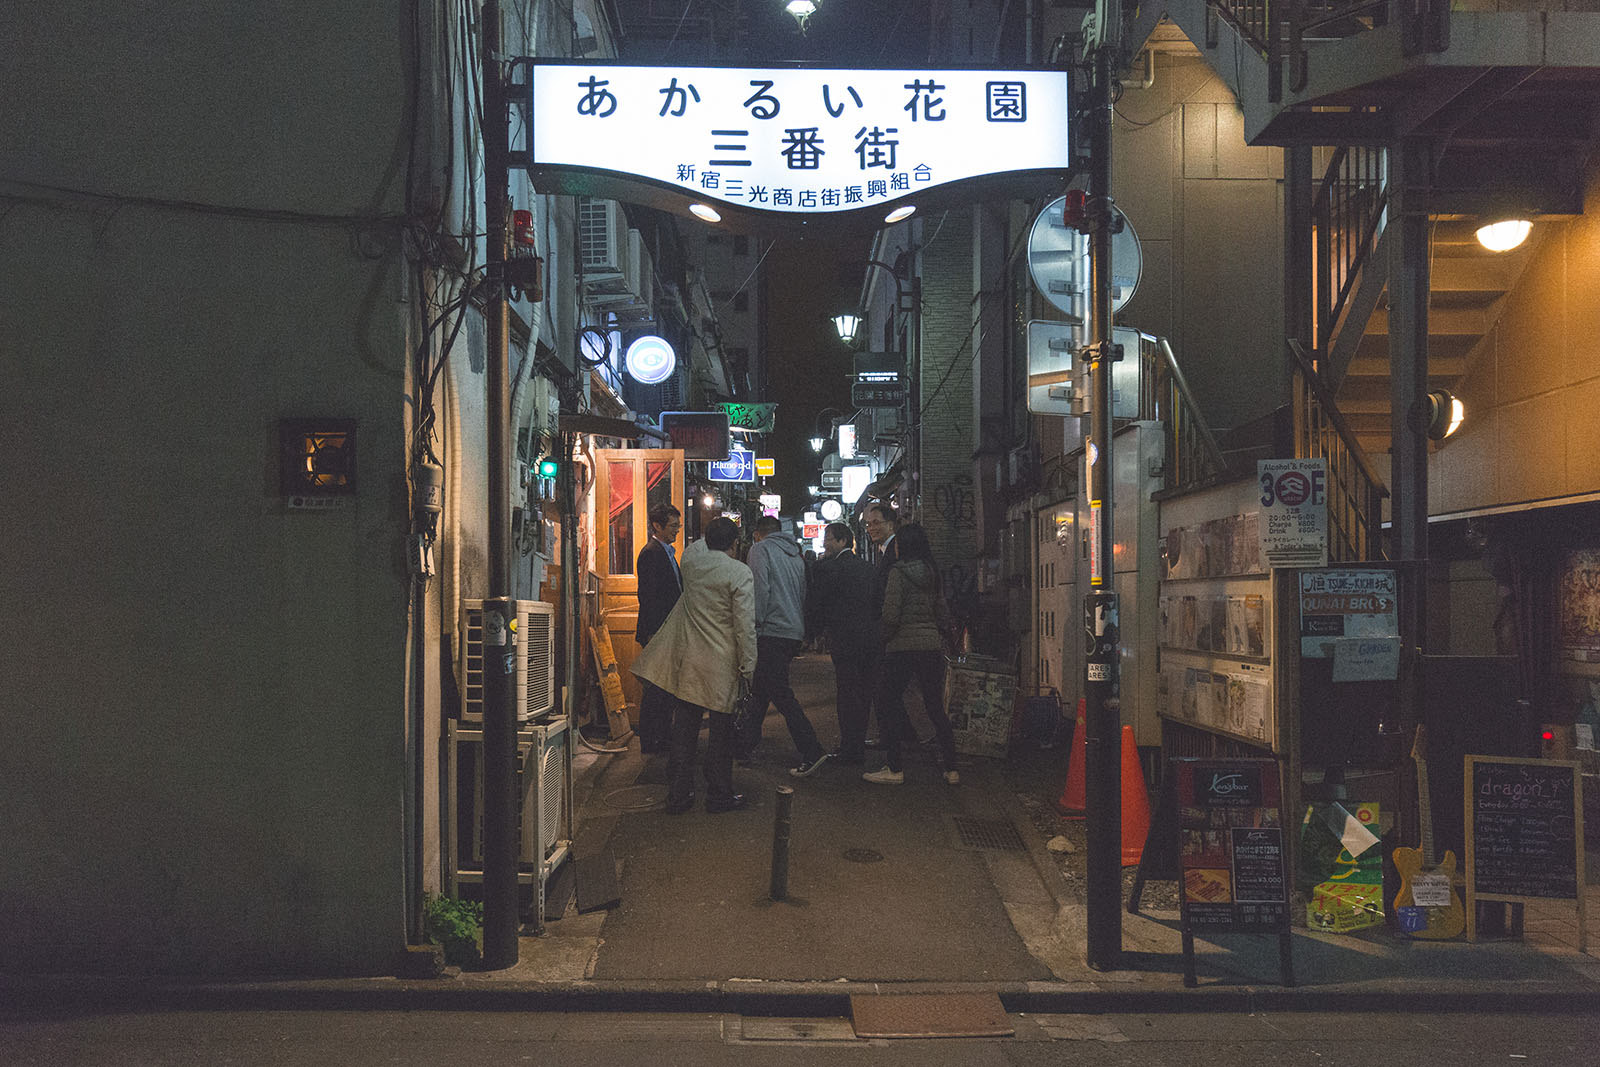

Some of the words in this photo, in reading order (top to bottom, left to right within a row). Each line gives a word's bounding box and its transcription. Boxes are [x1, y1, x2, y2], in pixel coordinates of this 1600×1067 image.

[577, 75, 1028, 122] あかるい花園
[709, 126, 900, 170] 三番街
[676, 163, 932, 208] 新宿三光商店街振興組合
[1263, 462, 1290, 471] Alcohol
[1300, 461, 1321, 470] Foods
